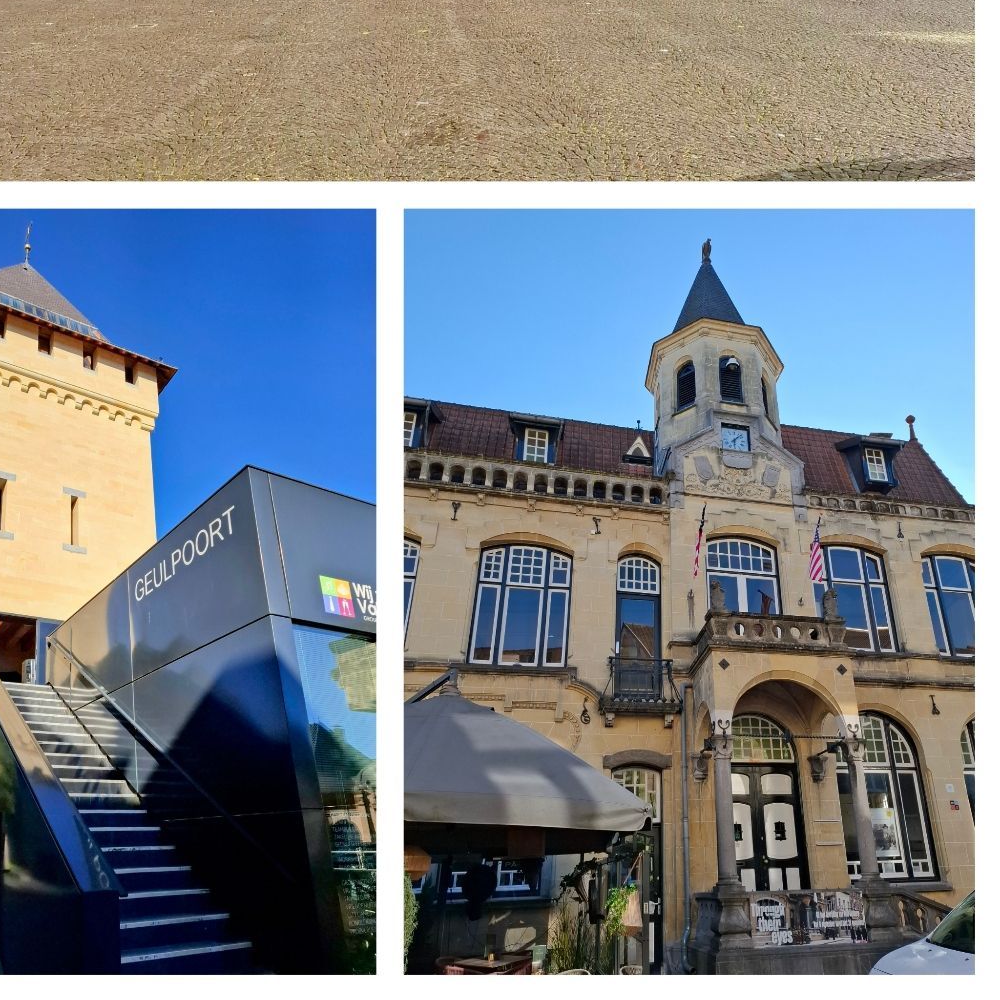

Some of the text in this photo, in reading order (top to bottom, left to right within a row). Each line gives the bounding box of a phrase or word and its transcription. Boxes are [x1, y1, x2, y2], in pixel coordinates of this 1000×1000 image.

[134, 504, 236, 602] GEULPOORT
[352, 582, 374, 604] Wij
[771, 930, 794, 946] eyes
